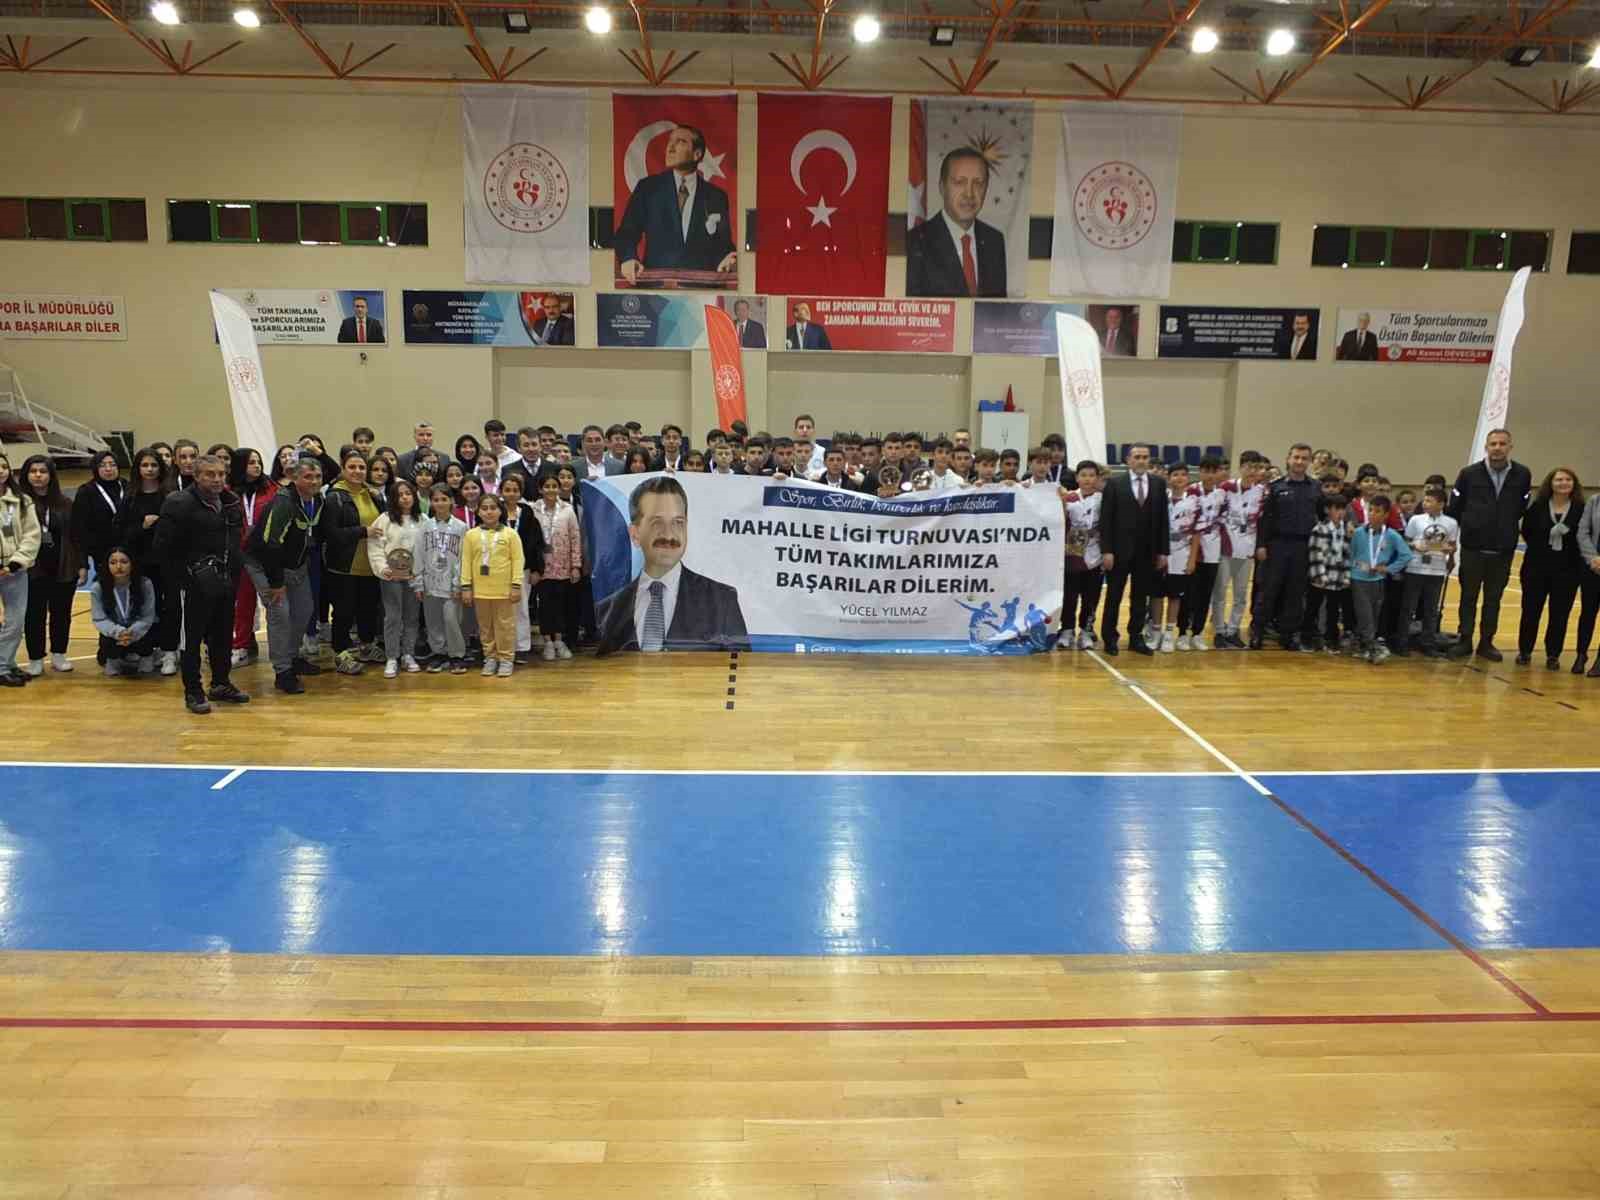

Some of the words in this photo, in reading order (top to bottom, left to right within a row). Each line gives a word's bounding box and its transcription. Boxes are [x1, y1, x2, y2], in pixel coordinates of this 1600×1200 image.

[24, 300, 35, 314] İL
[38, 301, 114, 315] MÜDÜRLÜĞÜ
[257, 307, 273, 315] TÜM
[275, 307, 318, 315] TAKIMLARA
[15, 321, 82, 334] BAŞARILAR
[86, 321, 120, 333] DİLER
[260, 317, 326, 325] SPORCULARIMIZA
[1389, 313, 1411, 325] Tüm
[1414, 314, 1488, 329] Sporcularımıza
[1378, 328, 1408, 341] Üstün
[1410, 330, 1456, 344] Başarılar
[1459, 331, 1495, 344] Dilerim
[721, 519, 825, 540] MAHALLE
[830, 523, 871, 543] LİGİ
[876, 526, 1051, 545] TURNUVASI'NDA
[775, 544, 822, 565] TÜM
[827, 551, 999, 570] TAKIMLARIMIZA
[776, 572, 896, 594] BAŞARILAR
[901, 575, 995, 593] DİLERİM.
[840, 603, 878, 616] YÜCEL
[882, 606, 928, 617] YILMAZ
